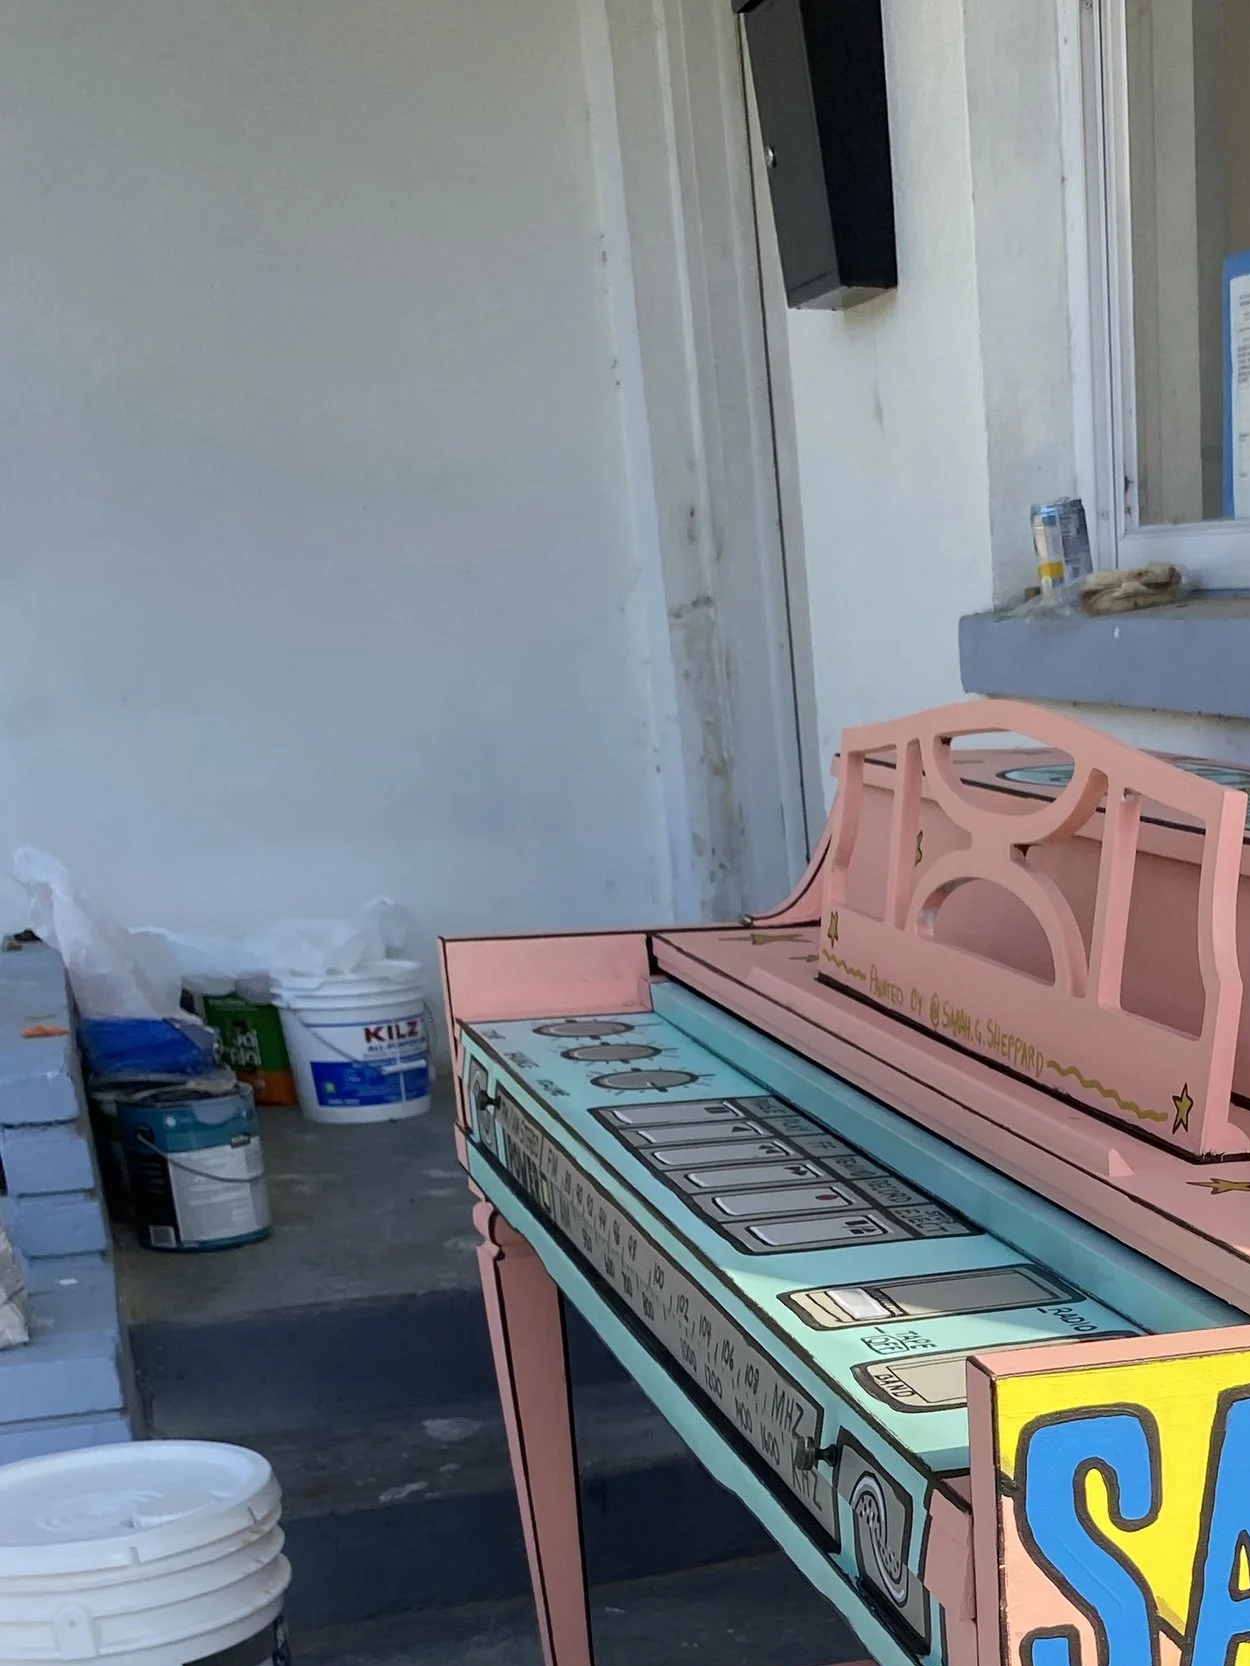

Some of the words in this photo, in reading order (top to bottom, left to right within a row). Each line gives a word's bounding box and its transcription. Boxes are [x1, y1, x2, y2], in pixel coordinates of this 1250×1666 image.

[364, 1020, 419, 1043] KILZ
[866, 1179, 912, 1204] RECORD
[894, 1207, 949, 1234] EJECT
[1047, 1307, 1098, 1332] RADIO
[653, 1263, 665, 1290] 100
[676, 1294, 689, 1322] 102
[699, 1315, 712, 1347] 104
[721, 1339, 734, 1371] 106
[745, 1366, 760, 1396] 108
[771, 1381, 805, 1439] MHZ
[868, 1334, 902, 1354] OFF
[902, 1329, 938, 1350] TAPE
[874, 1373, 917, 1399] BAND
[680, 1337, 697, 1373] 1000
[704, 1362, 723, 1399] 1200
[735, 1396, 753, 1434] 1400
[760, 1423, 780, 1466] 1600
